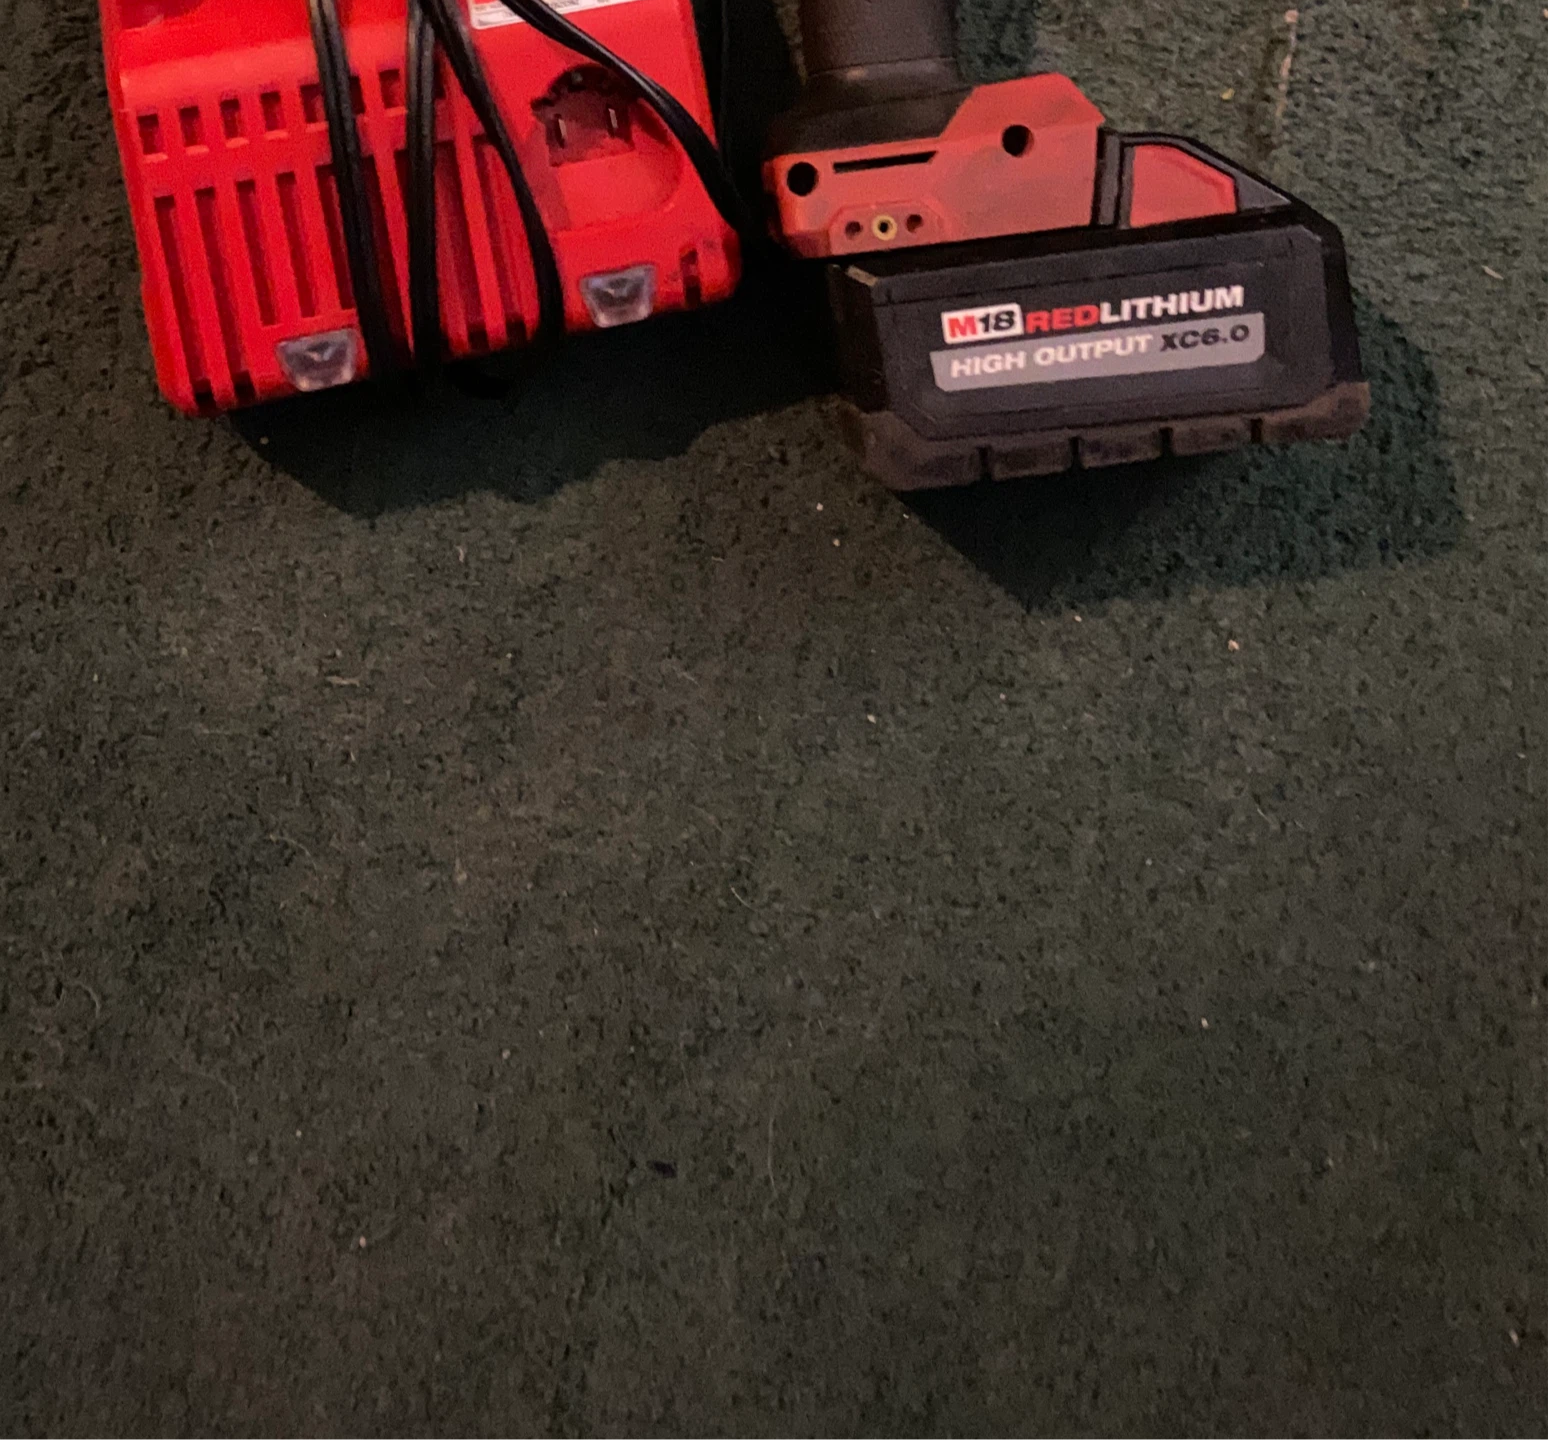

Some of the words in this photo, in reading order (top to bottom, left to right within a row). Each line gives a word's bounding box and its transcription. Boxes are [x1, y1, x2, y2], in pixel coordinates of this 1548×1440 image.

[949, 309, 1015, 338] M18
[951, 350, 1027, 378] HIGH
[1033, 333, 1153, 366] OUTPUT
[1160, 324, 1250, 352] XC6.0
